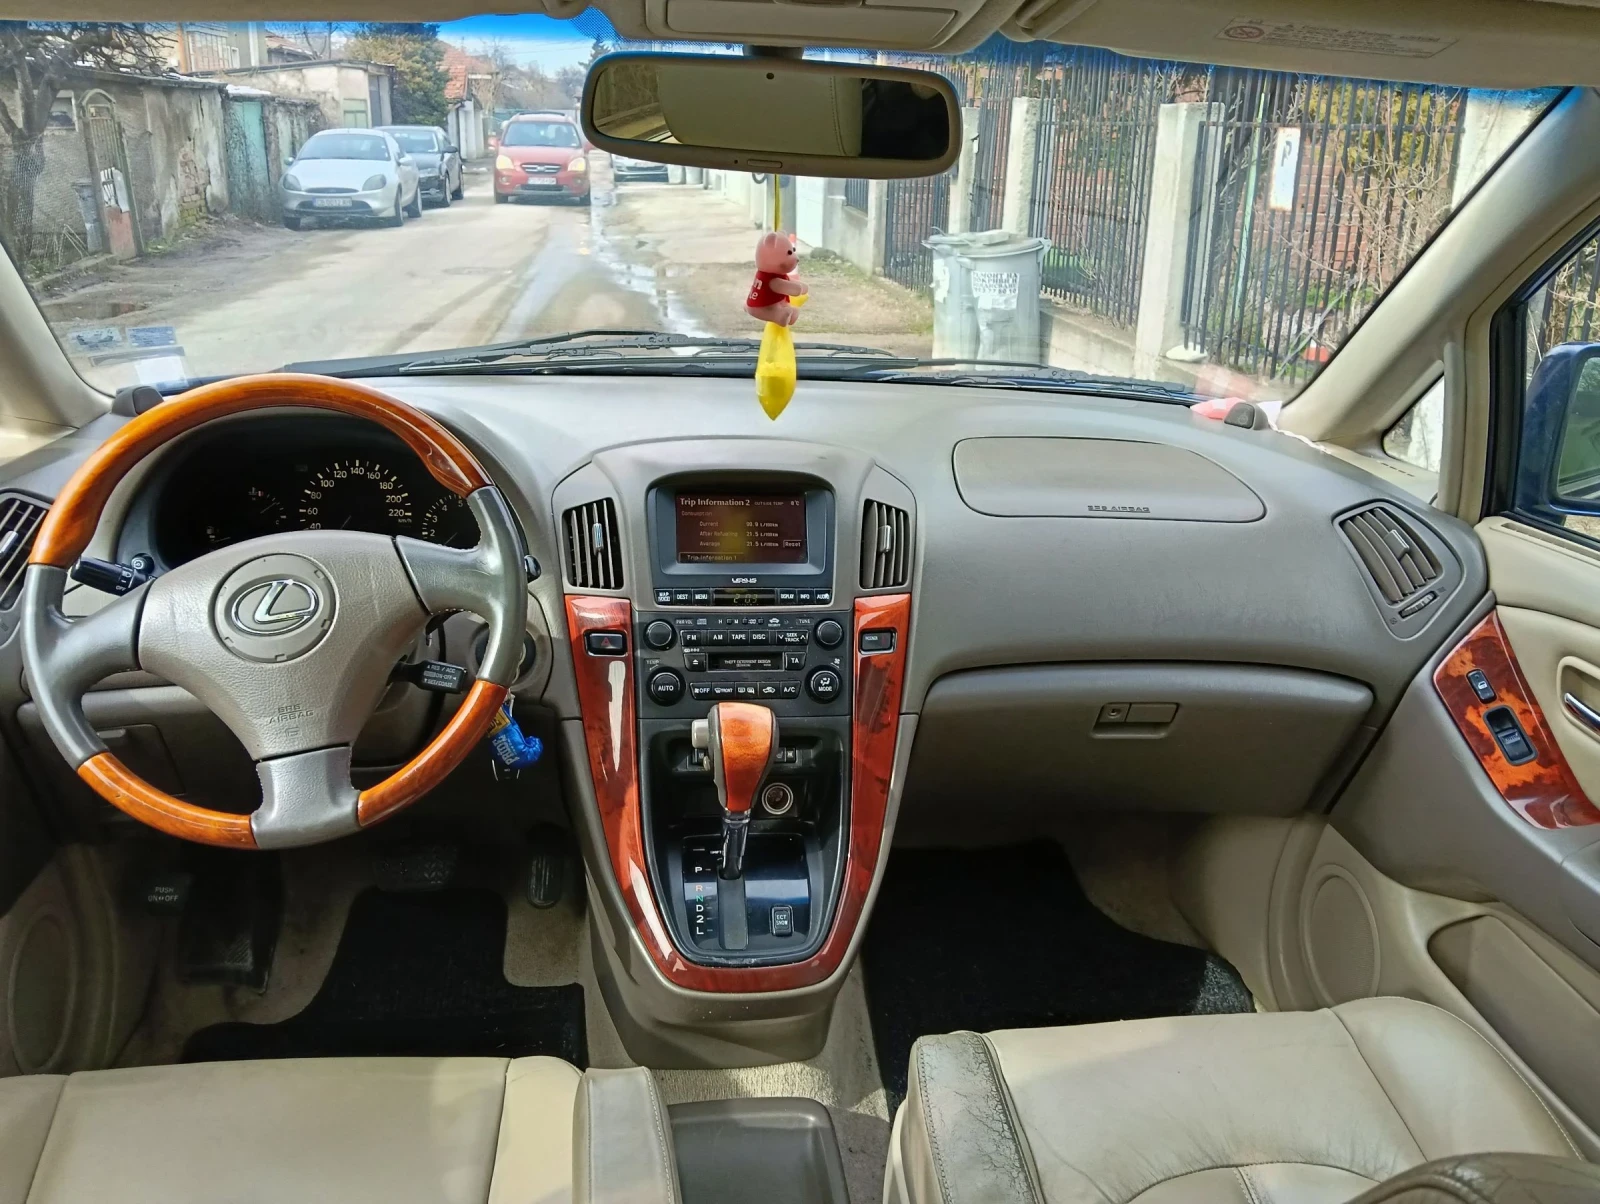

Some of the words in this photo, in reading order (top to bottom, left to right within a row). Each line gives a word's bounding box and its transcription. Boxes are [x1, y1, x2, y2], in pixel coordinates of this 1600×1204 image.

[350, 467, 364, 475] 140
[320, 480, 334, 488] 100
[310, 491, 322, 499] 80
[385, 495, 402, 503] 200
[680, 498, 695, 507] Trip
[697, 498, 744, 506] Information
[307, 507, 318, 515] 60
[441, 504, 448, 512] 4
[388, 509, 405, 517] 220
[432, 515, 438, 523] 3
[309, 522, 321, 530] 40
[429, 529, 436, 537] 2
[278, 704, 301, 713] SRS
[269, 710, 314, 724] AIRBAG
[695, 866, 703, 874] P
[155, 886, 174, 894] PUSH
[696, 904, 704, 912] D
[696, 914, 704, 924] 2
[696, 926, 704, 935] L
